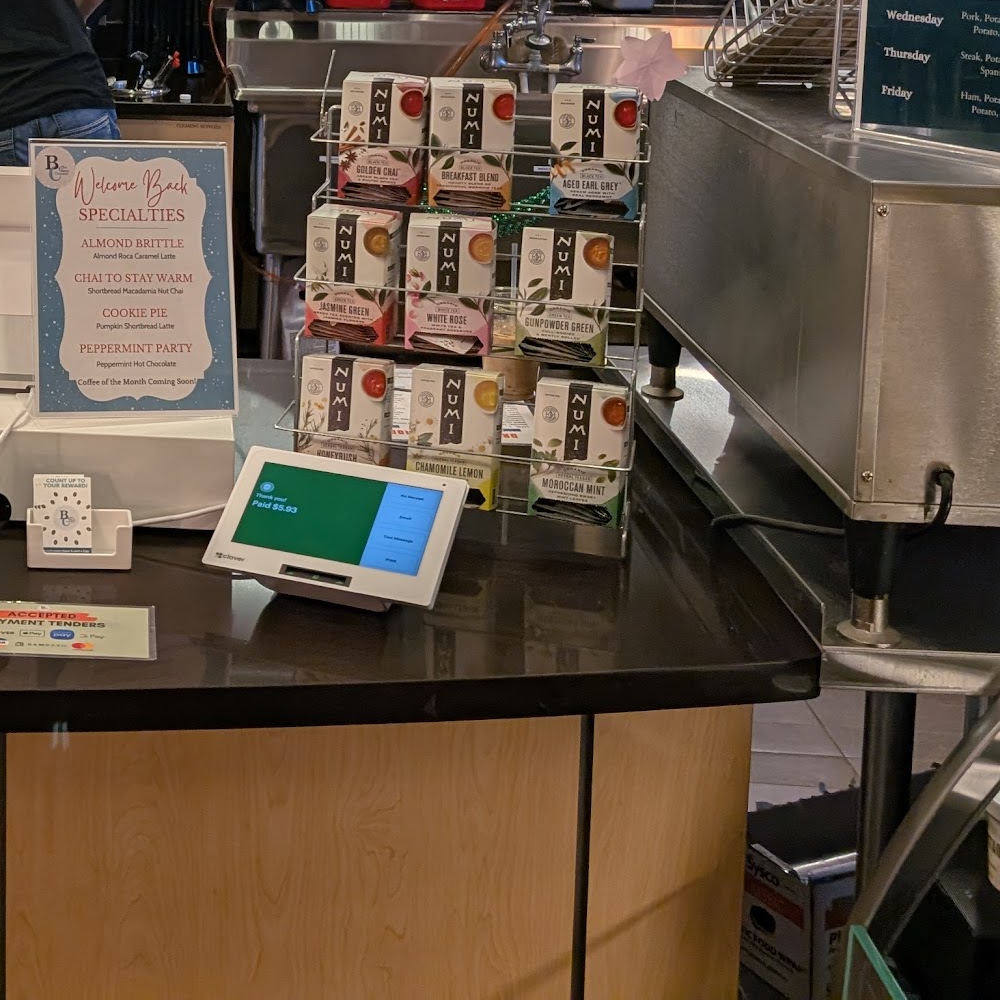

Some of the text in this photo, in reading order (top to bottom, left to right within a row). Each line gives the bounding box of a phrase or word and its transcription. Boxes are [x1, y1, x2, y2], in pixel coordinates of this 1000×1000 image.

[886, 9, 944, 27] Wednesday
[961, 11, 983, 23] Pork,
[883, 46, 931, 64] Thursday
[960, 50, 983, 62] Steak,
[881, 84, 913, 100] Friday
[960, 90, 982, 103] Ham,
[371, 88, 389, 140] NUMI
[971, 105, 999, 118] Potato,
[463, 93, 480, 145] NUMI
[584, 100, 602, 153] NUMI
[356, 164, 382, 176] GOLDEN
[441, 171, 499, 182] BREAKFAST BLEND
[74, 167, 188, 207] Welcome Back
[562, 179, 619, 191] AGED EARL GREY
[78, 208, 185, 222] SPECIALTIES
[81, 238, 184, 249] ALMOND BRITTLE
[337, 225, 353, 277] NUMI
[440, 233, 457, 286] NUMI
[553, 236, 572, 291] NUMI
[74, 273, 193, 283] CHAI TO STAY WARM
[102, 308, 168, 318] COOKIE PIE
[318, 301, 370, 317] JASMINE GREEN
[426, 313, 467, 325] WHITE ROSE
[524, 317, 594, 333] GUNPOWDER GREEN
[79, 343, 193, 354] PEPPERMINT PARTY
[77, 377, 197, 388] Coffee of the Month Coming Soon!
[332, 366, 349, 422] NUMI
[444, 378, 461, 435] NUMI
[568, 393, 587, 451] NUMI
[415, 461, 484, 479] CHAMOMILE LEMON
[541, 477, 606, 496] MOROCCAN MINT
[255, 491, 273, 500] Thank
[251, 499, 298, 514] Paid $5.93
[222, 553, 246, 563] clover
[7, 611, 77, 619] ACCEPTED
[49, 620, 106, 628] TENDERS
